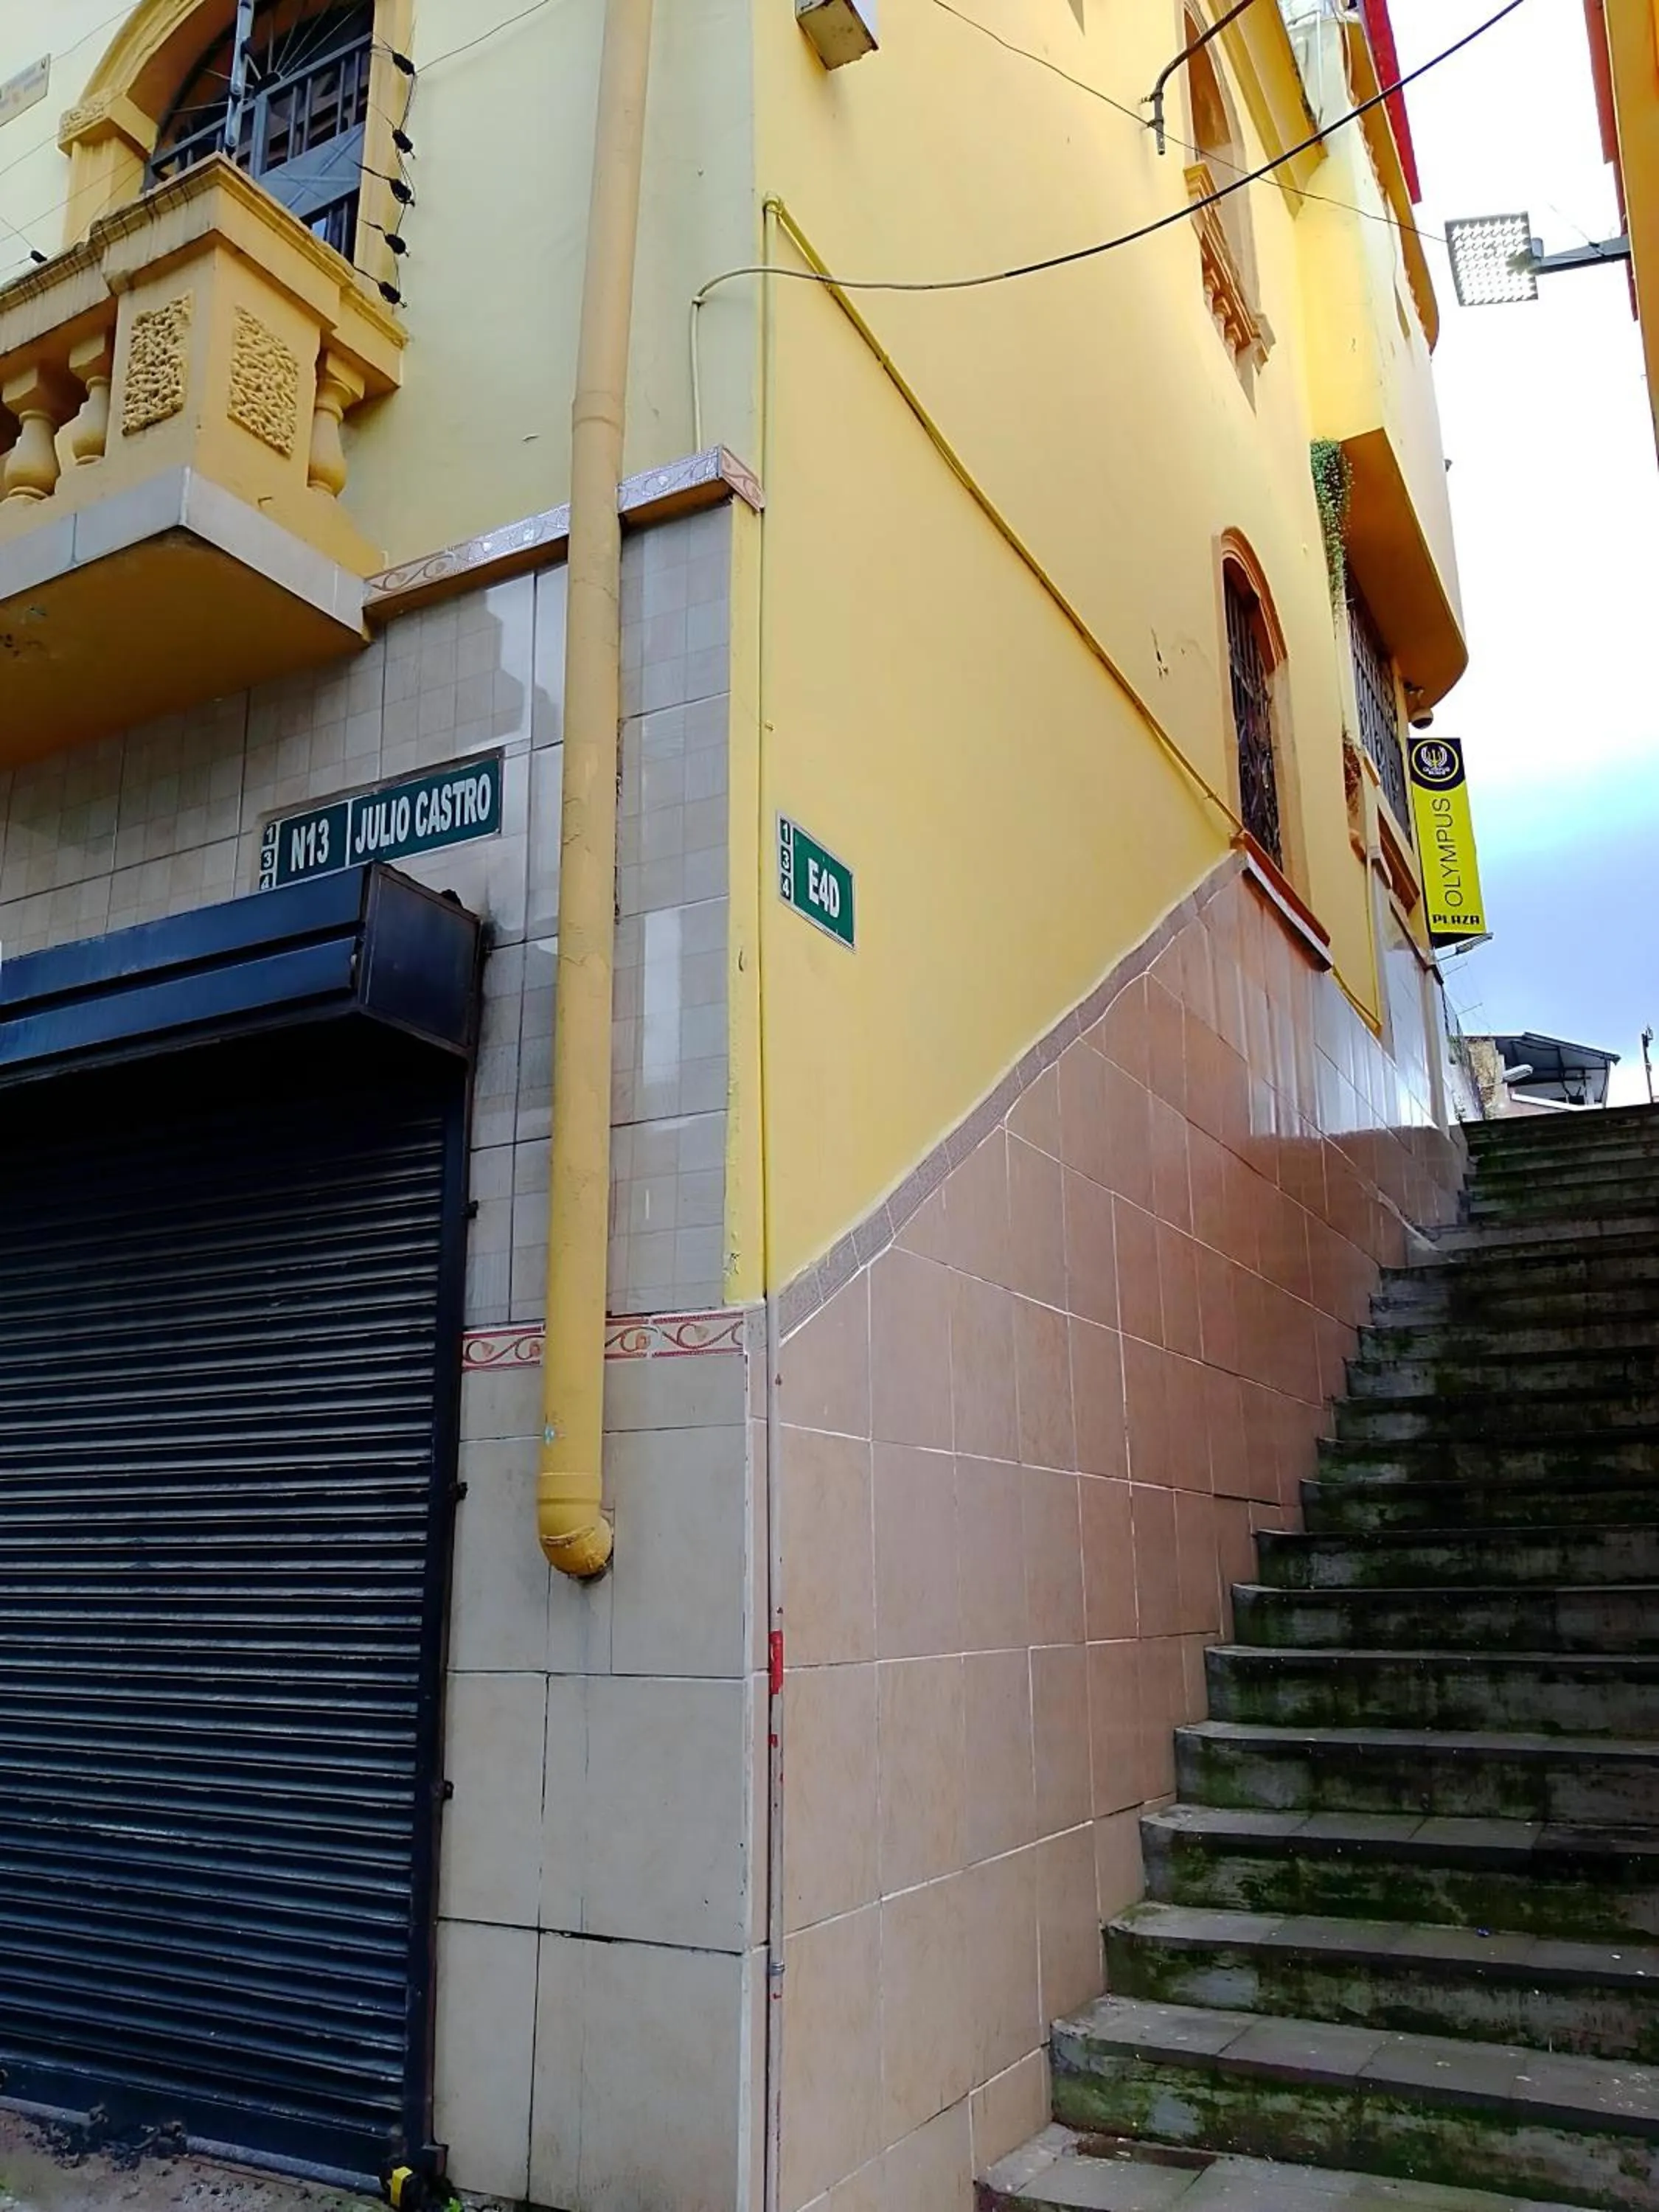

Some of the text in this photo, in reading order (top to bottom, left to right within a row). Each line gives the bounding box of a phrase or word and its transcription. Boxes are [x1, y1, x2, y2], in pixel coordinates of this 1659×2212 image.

[291, 773, 491, 872] N13 JULIO CASTRO
[1432, 798, 1464, 907] OLYMPUS
[808, 858, 840, 918] E4D
[1432, 914, 1480, 926] PLAZA
